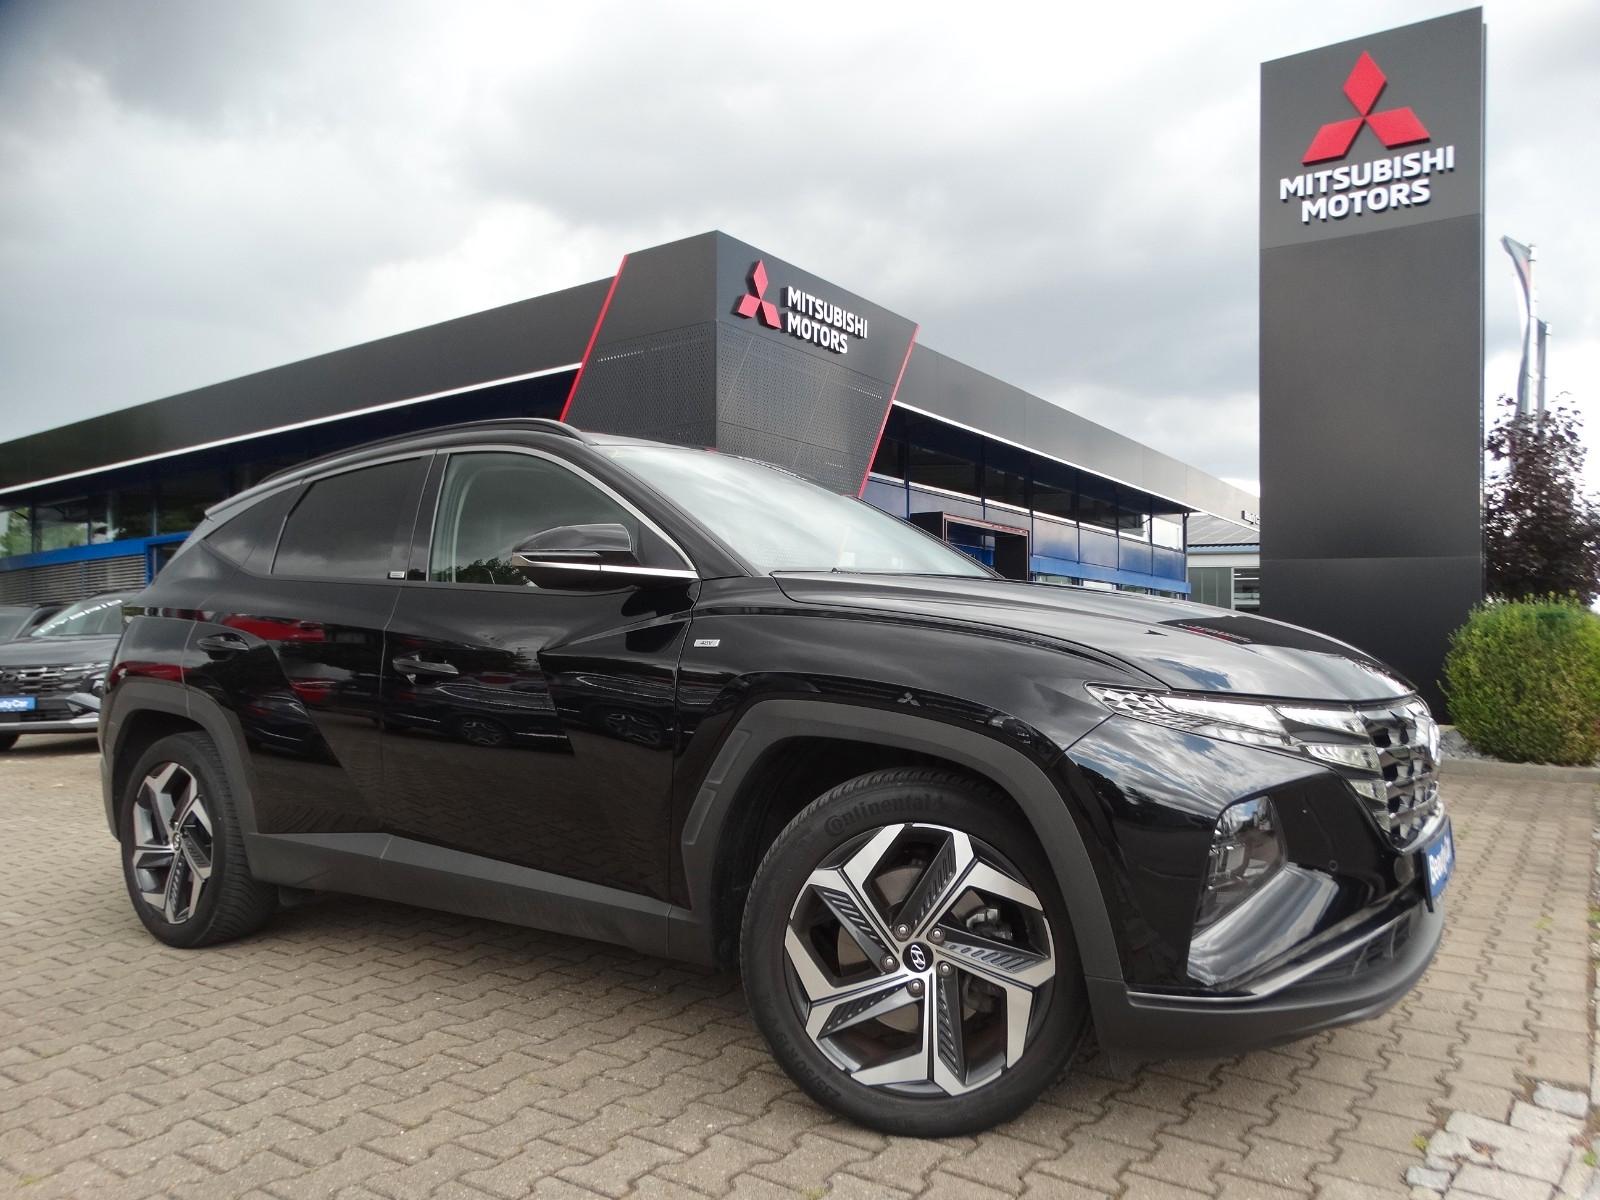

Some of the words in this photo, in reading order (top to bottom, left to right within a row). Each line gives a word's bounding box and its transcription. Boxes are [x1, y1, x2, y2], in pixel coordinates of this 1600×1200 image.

[1279, 145, 1455, 200] MITSUBISHI
[1301, 178, 1431, 223] MOTORS
[787, 285, 868, 339] MITSUBISHI
[787, 312, 848, 354] MOTORS
[824, 793, 930, 836] Continental
